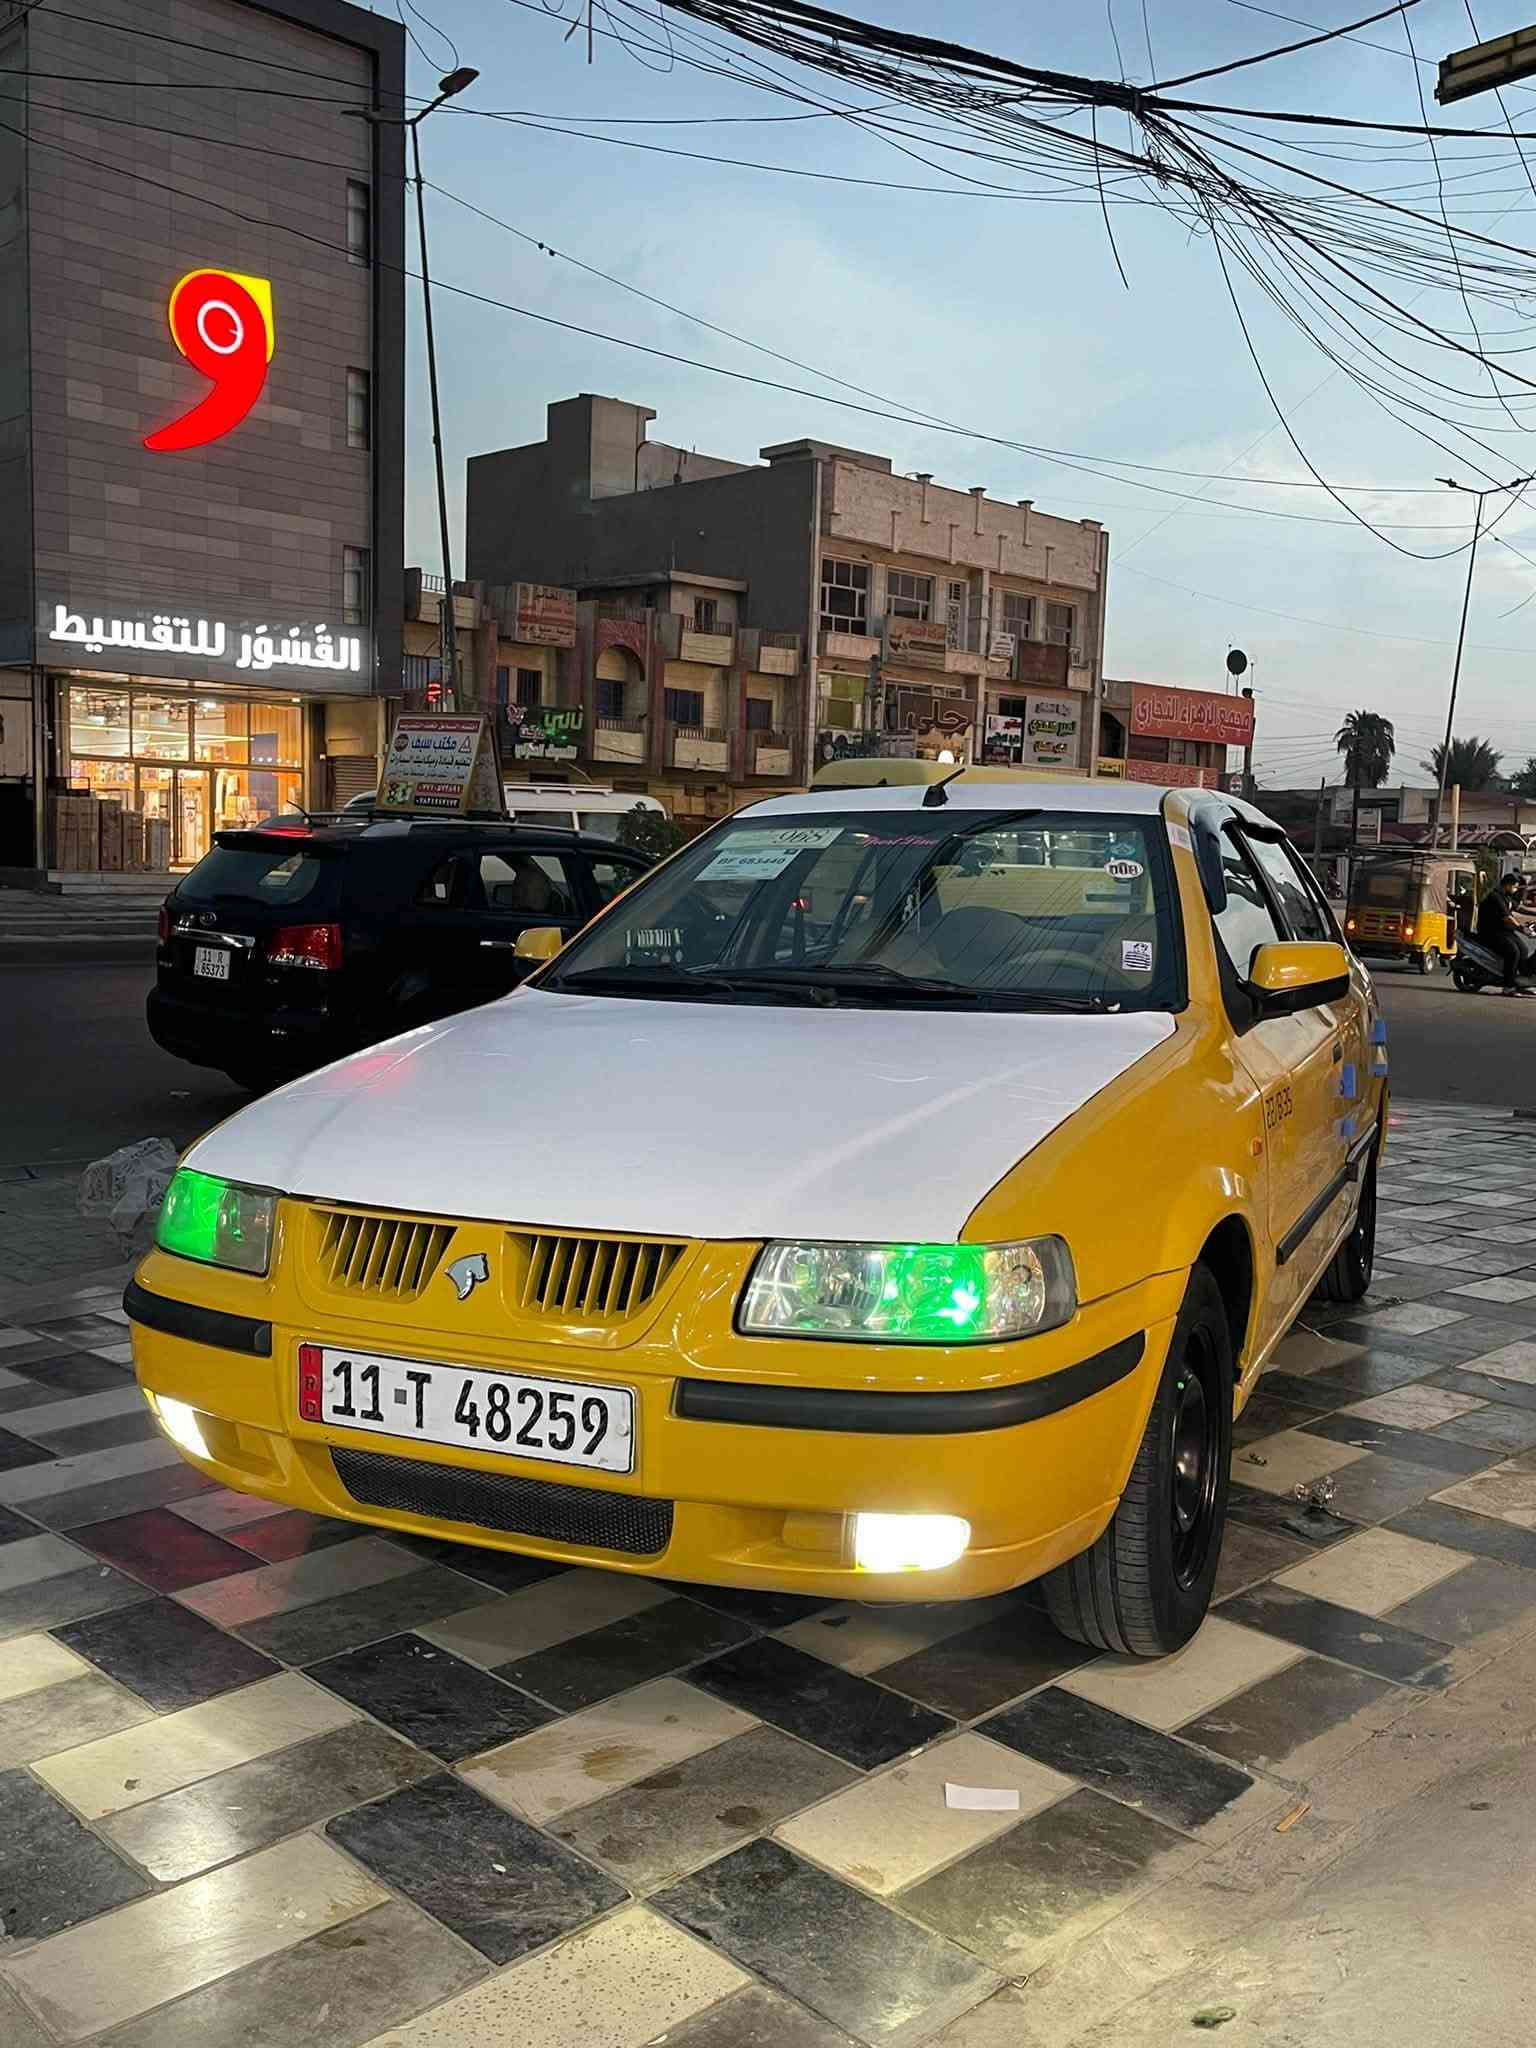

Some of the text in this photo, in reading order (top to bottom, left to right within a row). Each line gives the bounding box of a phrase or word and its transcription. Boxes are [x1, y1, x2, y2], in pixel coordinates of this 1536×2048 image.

[49, 605, 225, 656] للتقسيط
[332, 1360, 609, 1455] 11 T 48259
